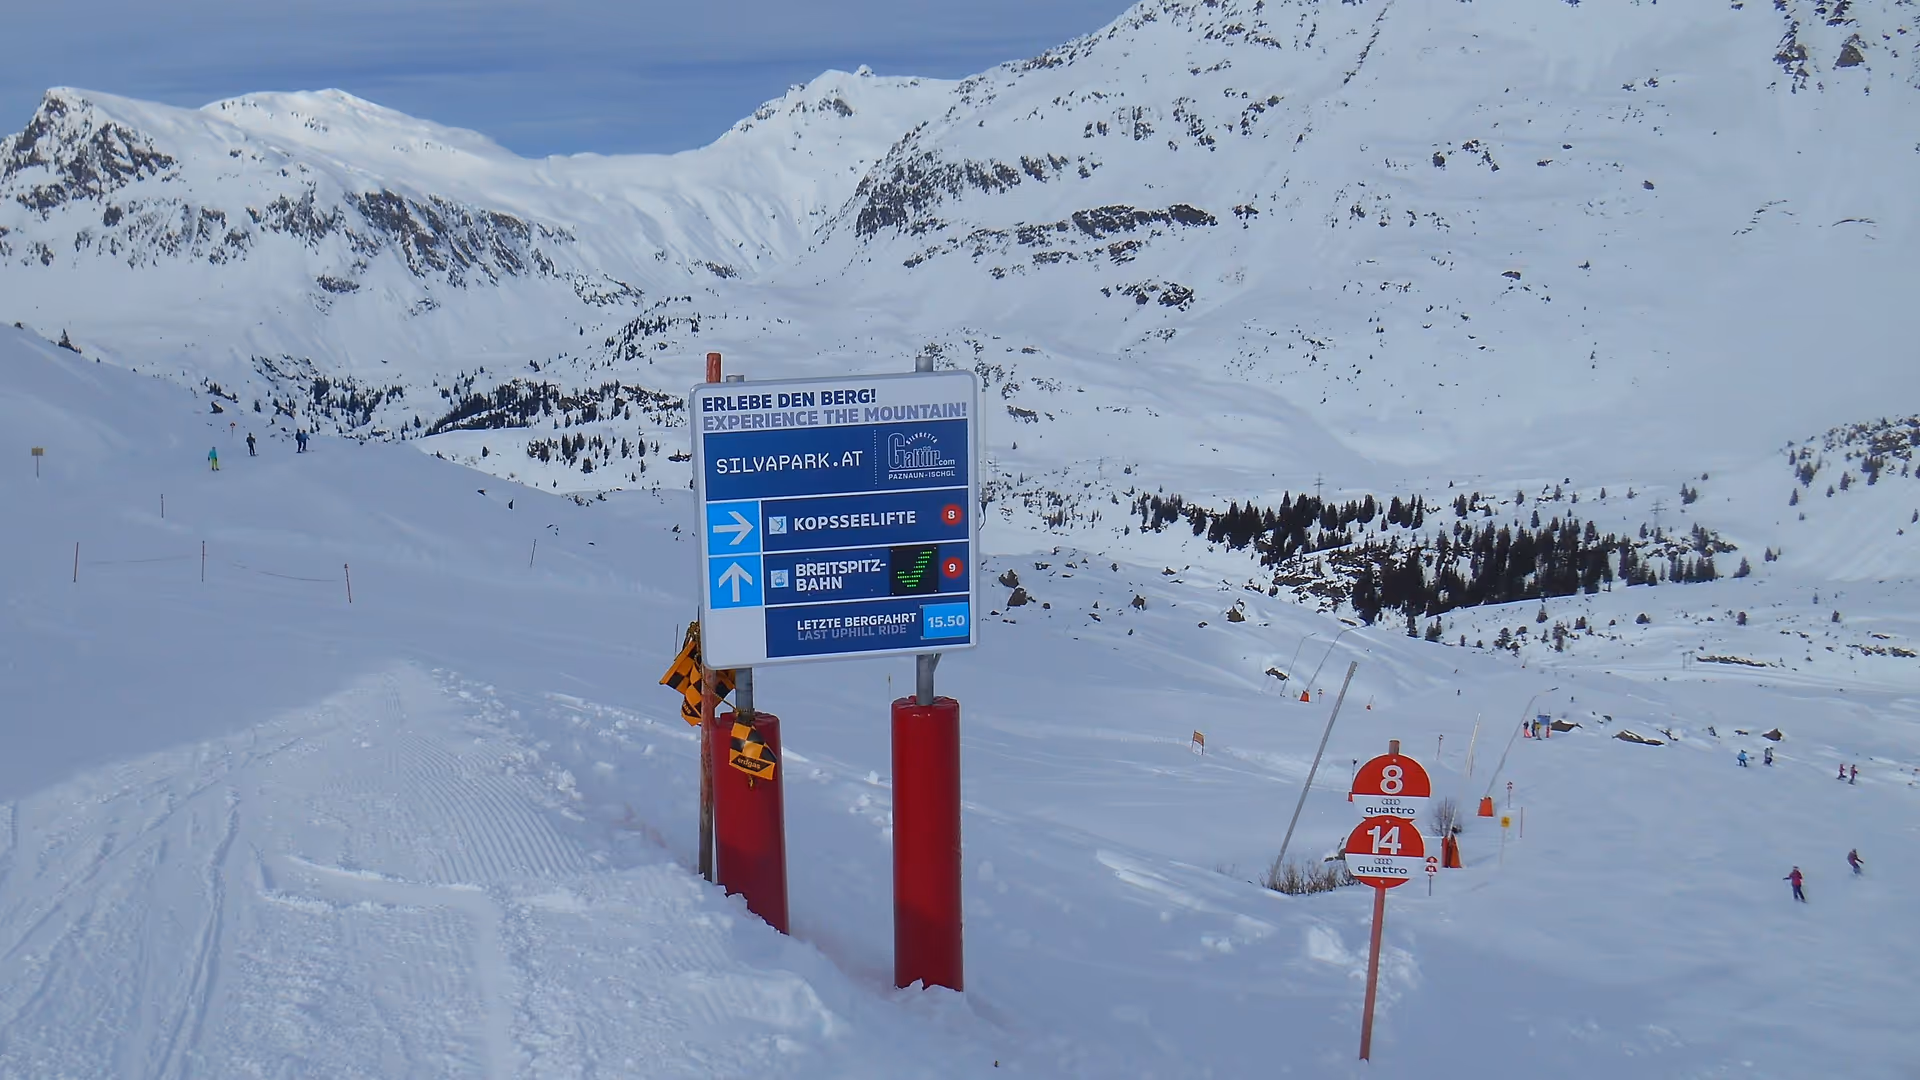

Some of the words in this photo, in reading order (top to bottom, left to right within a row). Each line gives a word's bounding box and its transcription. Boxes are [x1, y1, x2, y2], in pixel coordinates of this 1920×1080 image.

[702, 393, 772, 412] ERLEBE
[778, 391, 815, 409] DEN
[821, 388, 876, 406] BERG!
[703, 410, 818, 431] EXPERIENCE
[824, 408, 859, 424] THE
[865, 402, 967, 422] MOUNTAIN!
[716, 450, 863, 474] SILVAPARK.AT
[888, 470, 956, 480] PAZNAUN-ISCHGL
[794, 510, 916, 531] KOPSSEELIFTE
[947, 510, 955, 519] 8
[795, 558, 886, 577] BREITSPITZ-
[948, 563, 956, 573] 9
[796, 576, 843, 592] BAHN
[797, 616, 841, 631] LETZTE
[844, 612, 917, 628] BERGFAHRT
[927, 614, 966, 628] 15.50
[797, 629, 828, 641] LAST
[831, 626, 875, 639] UPHILL
[878, 624, 907, 636] RIDE
[1379, 764, 1404, 795] 8
[1365, 806, 1416, 815] quattro
[1367, 825, 1402, 855] 14
[1357, 865, 1408, 874] quattro
